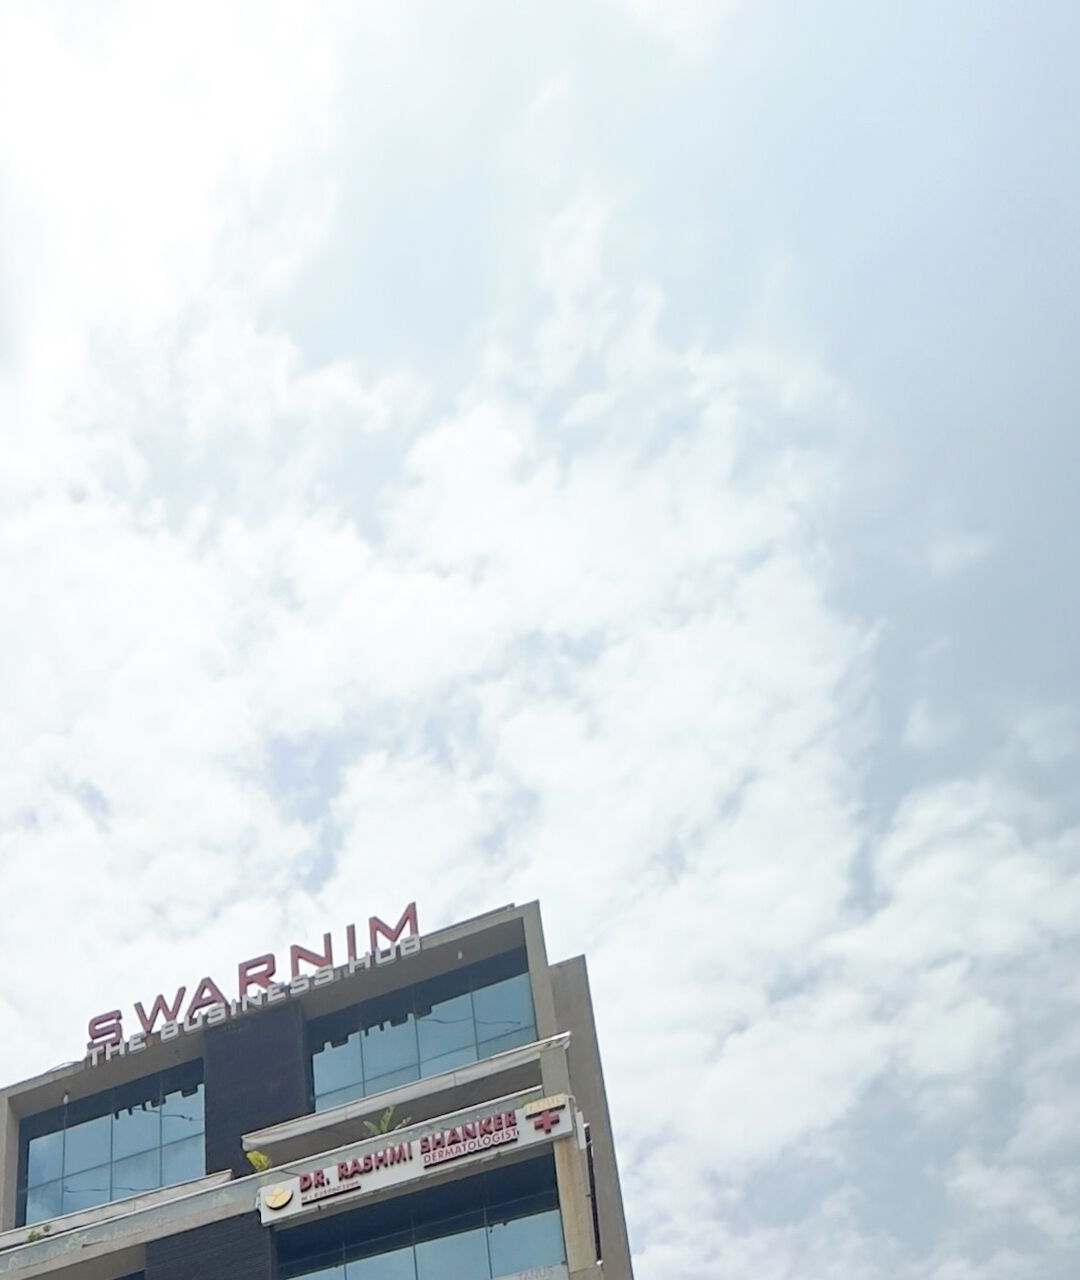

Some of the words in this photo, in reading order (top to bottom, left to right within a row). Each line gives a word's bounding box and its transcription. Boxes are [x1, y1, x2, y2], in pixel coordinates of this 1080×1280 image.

[87, 902, 419, 1047] SWARNIM
[87, 1037, 147, 1067] THE
[160, 964, 334, 1043] BUSINESS
[349, 934, 421, 975] HUB
[300, 1169, 331, 1193] DR.
[338, 1142, 414, 1181] RASHMI
[420, 1110, 518, 1155] SHANKER
[424, 1128, 520, 1165] DERMATOLOGIST
